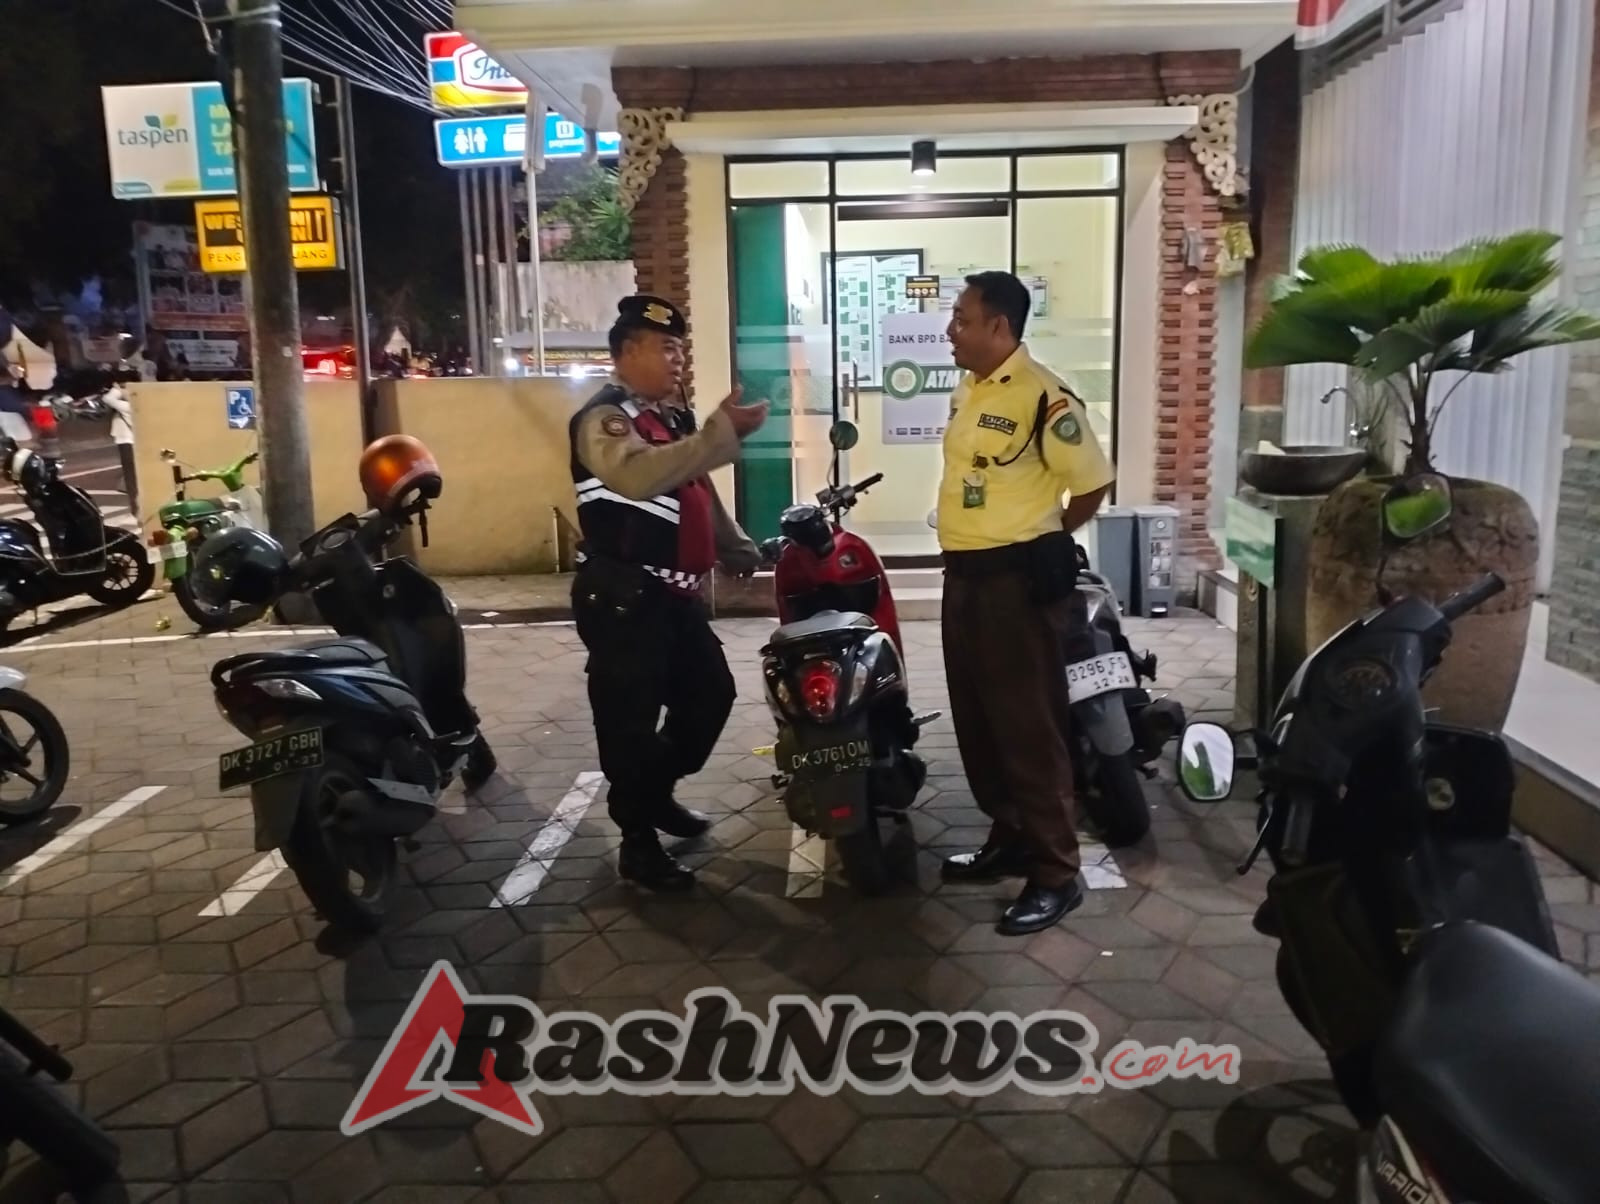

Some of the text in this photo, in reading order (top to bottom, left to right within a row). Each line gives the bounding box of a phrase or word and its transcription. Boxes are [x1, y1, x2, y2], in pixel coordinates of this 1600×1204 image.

[118, 126, 188, 148] taspen
[889, 334, 915, 344] BANK
[918, 334, 936, 344] BPD
[923, 370, 961, 388] ATM
[1068, 660, 1105, 682] 3296
[222, 753, 240, 772] DK
[245, 739, 282, 763] 3727
[792, 752, 810, 769] DK
[813, 745, 845, 765] 3761
